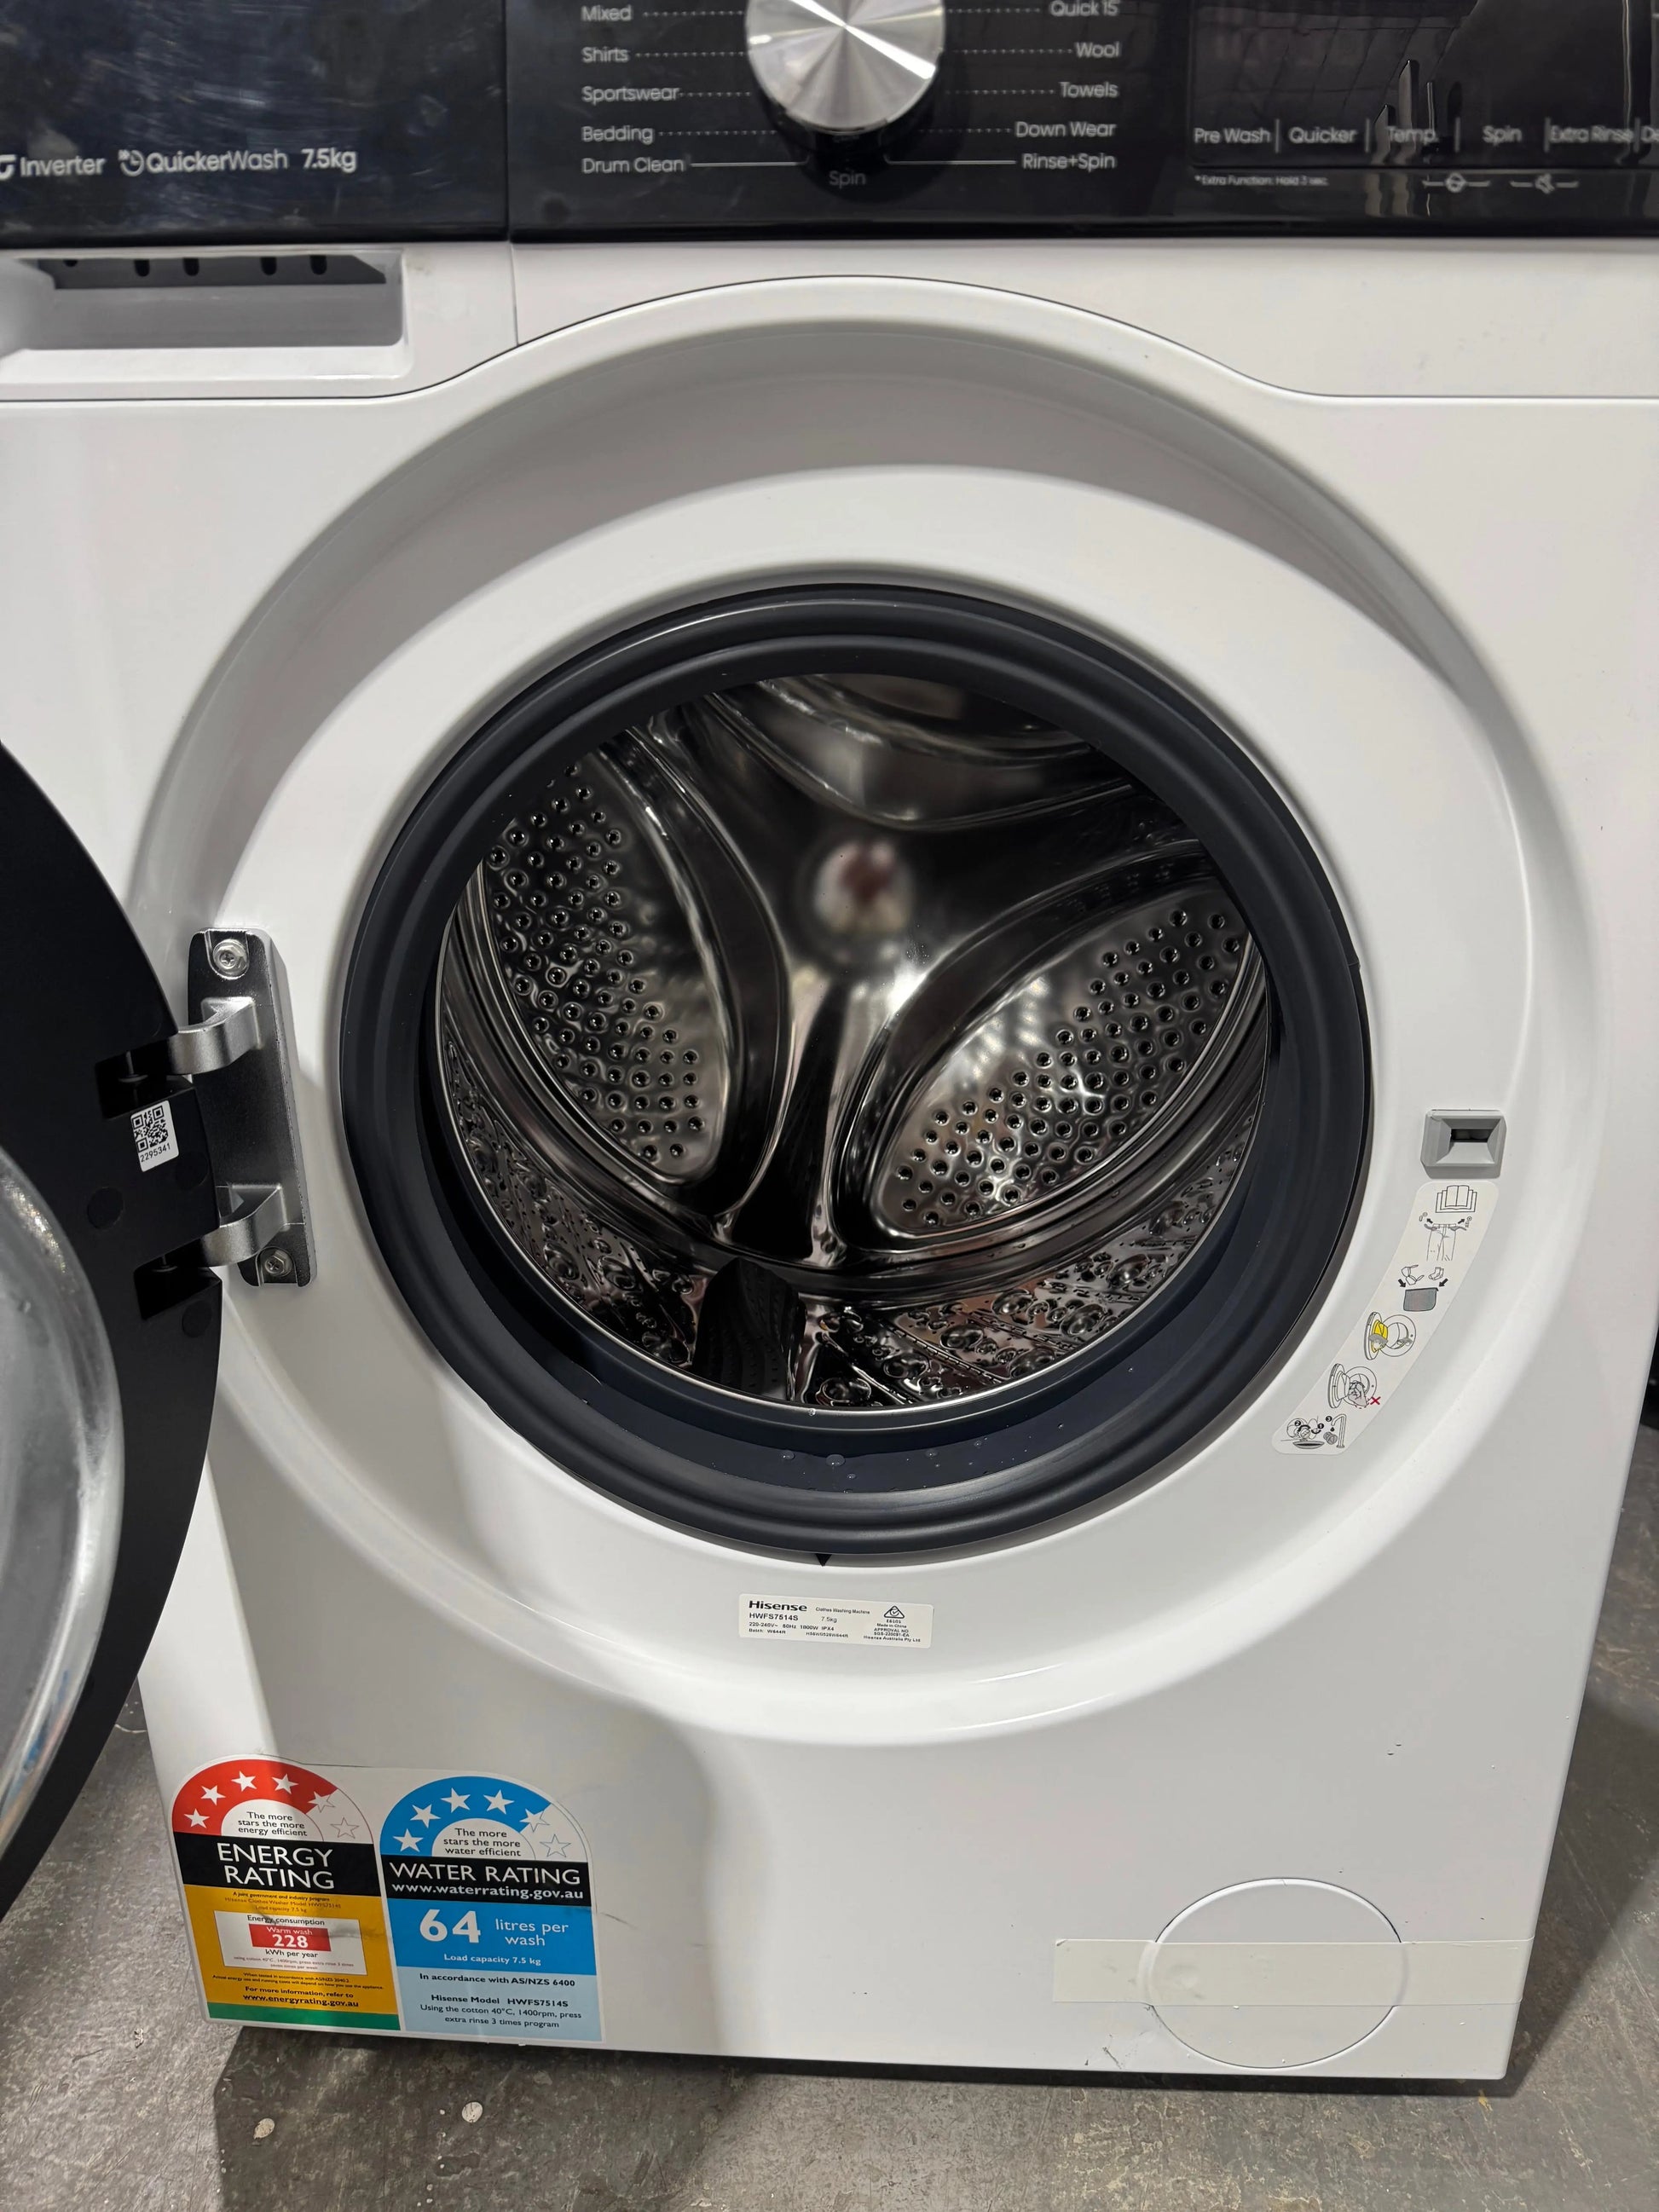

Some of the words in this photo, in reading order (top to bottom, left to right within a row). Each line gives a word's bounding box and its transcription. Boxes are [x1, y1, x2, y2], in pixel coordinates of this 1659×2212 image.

[581, 4, 631, 21] Mixed
[1049, 0, 1100, 16] Quick
[1102, 0, 1120, 16] 15
[581, 46, 629, 63] Shirts
[1075, 41, 1120, 58] Wool
[581, 85, 679, 103] Sportswear
[1060, 81, 1119, 98] Towels
[581, 124, 654, 145] Bedding
[1014, 121, 1066, 137] Down
[1067, 121, 1116, 137] Wear
[1194, 127, 1221, 144] Pre
[1223, 127, 1271, 143] Wash
[1288, 126, 1359, 144] Quicker
[1483, 125, 1523, 147] Spin
[1550, 124, 1589, 143] Extra
[20, 156, 106, 176] Inverter
[146, 148, 288, 174] QuickerWash
[302, 148, 357, 173] 7.5kg
[581, 158, 631, 173] Drum
[634, 157, 684, 173] Clean
[1021, 153, 1116, 172] Rinse+Spin
[830, 170, 866, 189] Spin
[140, 1143, 171, 1162] 2295341
[749, 1600, 807, 1612] Hisense
[749, 1613, 799, 1621] HWFS7514S
[246, 1811, 266, 1821] The
[238, 1828, 269, 1836] energy
[271, 1828, 308, 1837] efficient
[454, 1828, 476, 1837] The
[471, 1838, 490, 1846] the
[493, 1839, 521, 1848] more
[217, 1843, 333, 1868] ENERGY
[478, 1847, 522, 1857] efficient
[224, 1865, 335, 1890] RATING
[389, 1862, 477, 1881] WATER
[485, 1867, 581, 1886] RATING
[391, 1883, 583, 1900] www.waterrating.gov.au
[275, 1916, 325, 1926] consumption
[419, 1909, 481, 1943] 64
[495, 1919, 535, 1932] litres
[541, 1923, 569, 1936] per
[272, 1934, 309, 1949] 228
[505, 1935, 546, 1947] wash
[443, 1953, 468, 1961] Load
[470, 1955, 510, 1965] capacity
[529, 1958, 541, 1967] kg
[431, 1974, 486, 1983] accordance
[488, 1976, 509, 1984] with
[511, 1977, 550, 1986] AS/NZS
[243, 1994, 359, 2007] www.energyrating.gov.au
[420, 2004, 443, 2013] Using
[431, 1995, 468, 2003] Hisense
[507, 1998, 569, 2007] HWFS7514S
